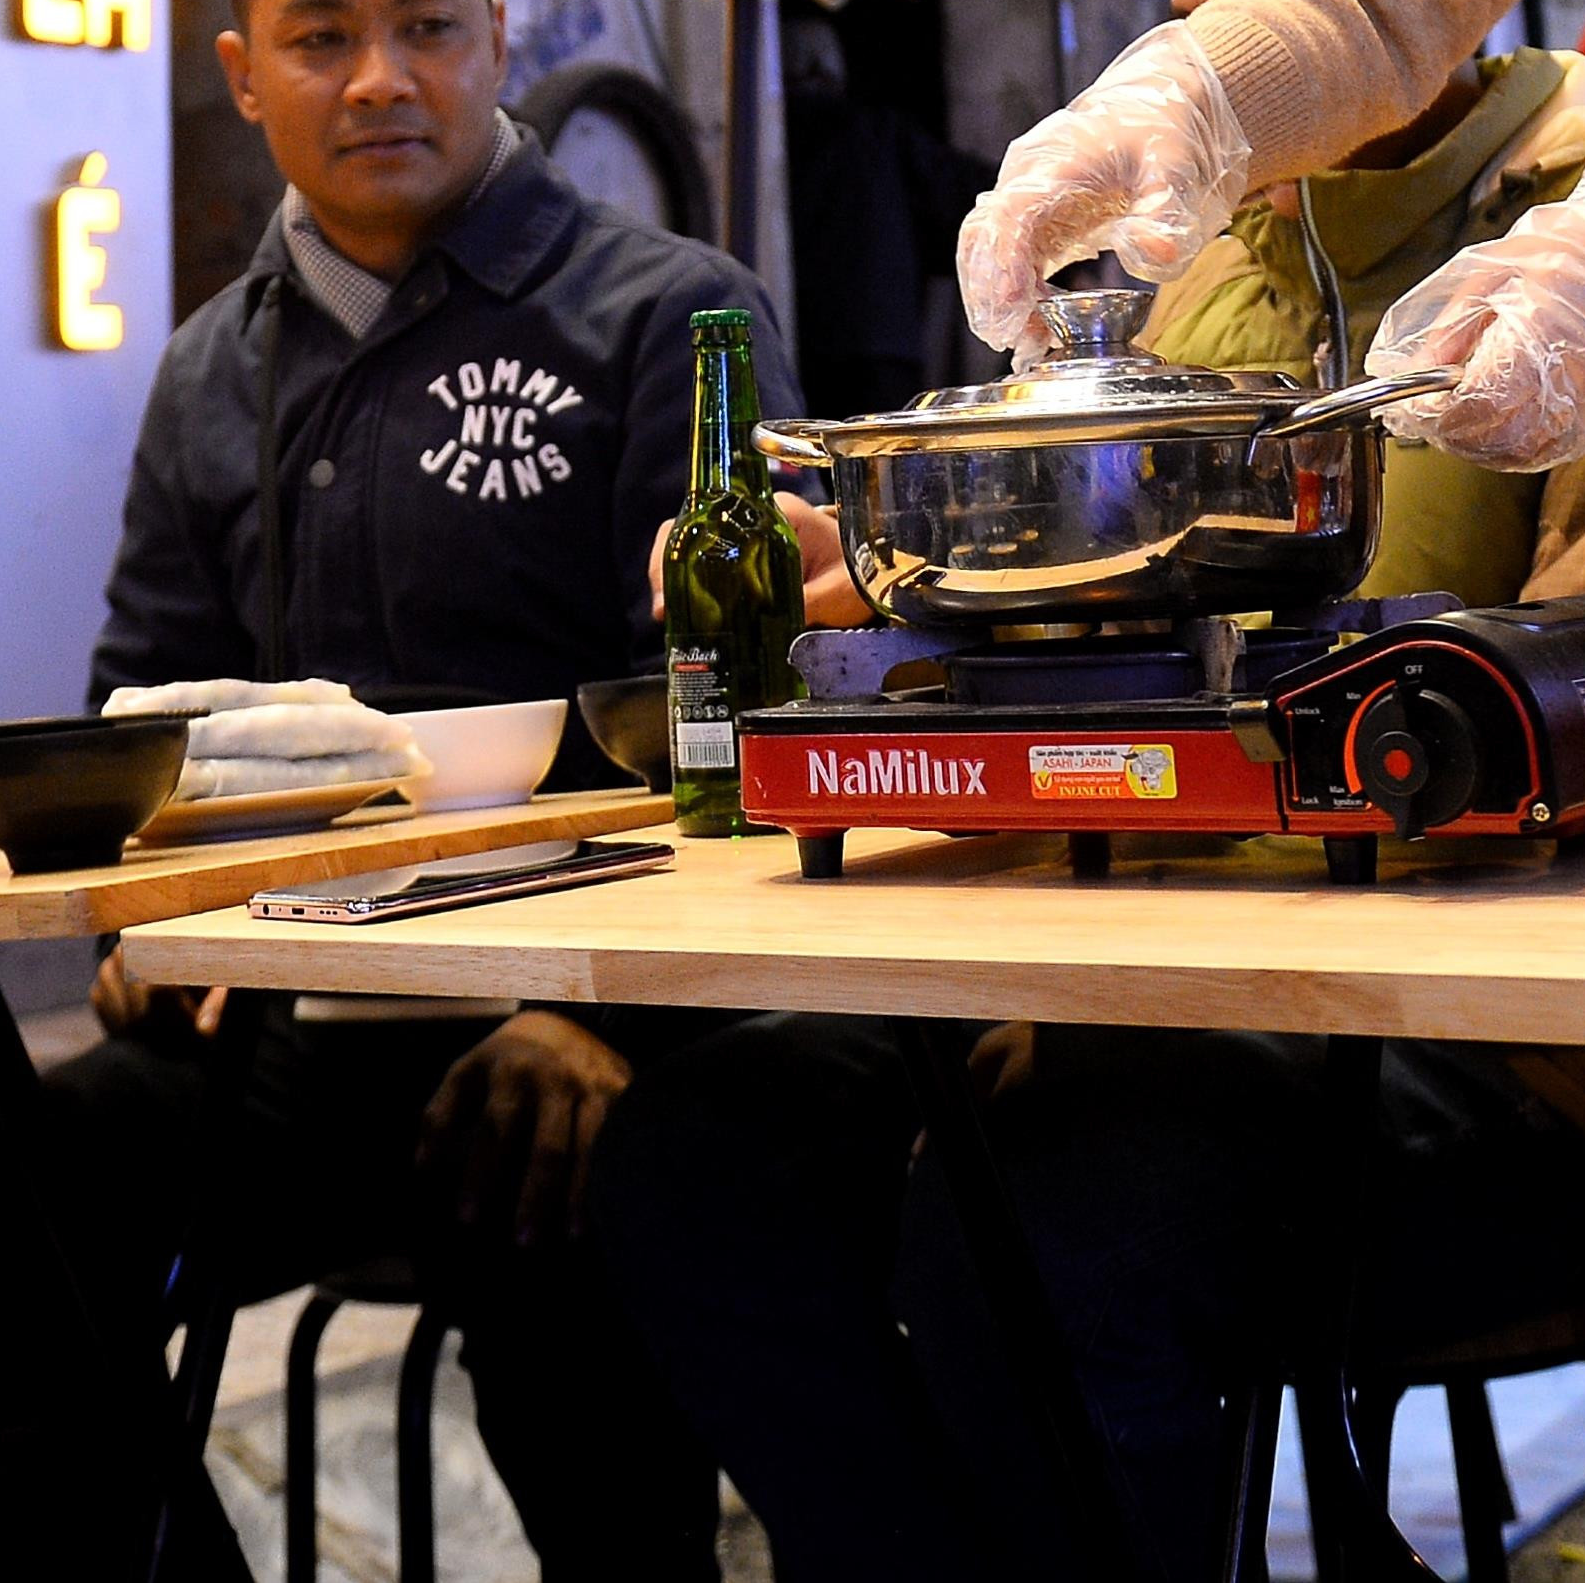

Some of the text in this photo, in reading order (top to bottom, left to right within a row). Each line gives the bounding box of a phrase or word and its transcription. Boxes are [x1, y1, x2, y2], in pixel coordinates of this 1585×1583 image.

[57, 150, 123, 351] É
[427, 357, 584, 415] TOMMY
[461, 404, 537, 450] NYC
[419, 439, 572, 501] JEANS
[1405, 665, 1423, 675] OFF
[1295, 707, 1320, 715] Unlock
[805, 749, 988, 795] NaMilux
[1080, 758, 1112, 768] JAPAN
